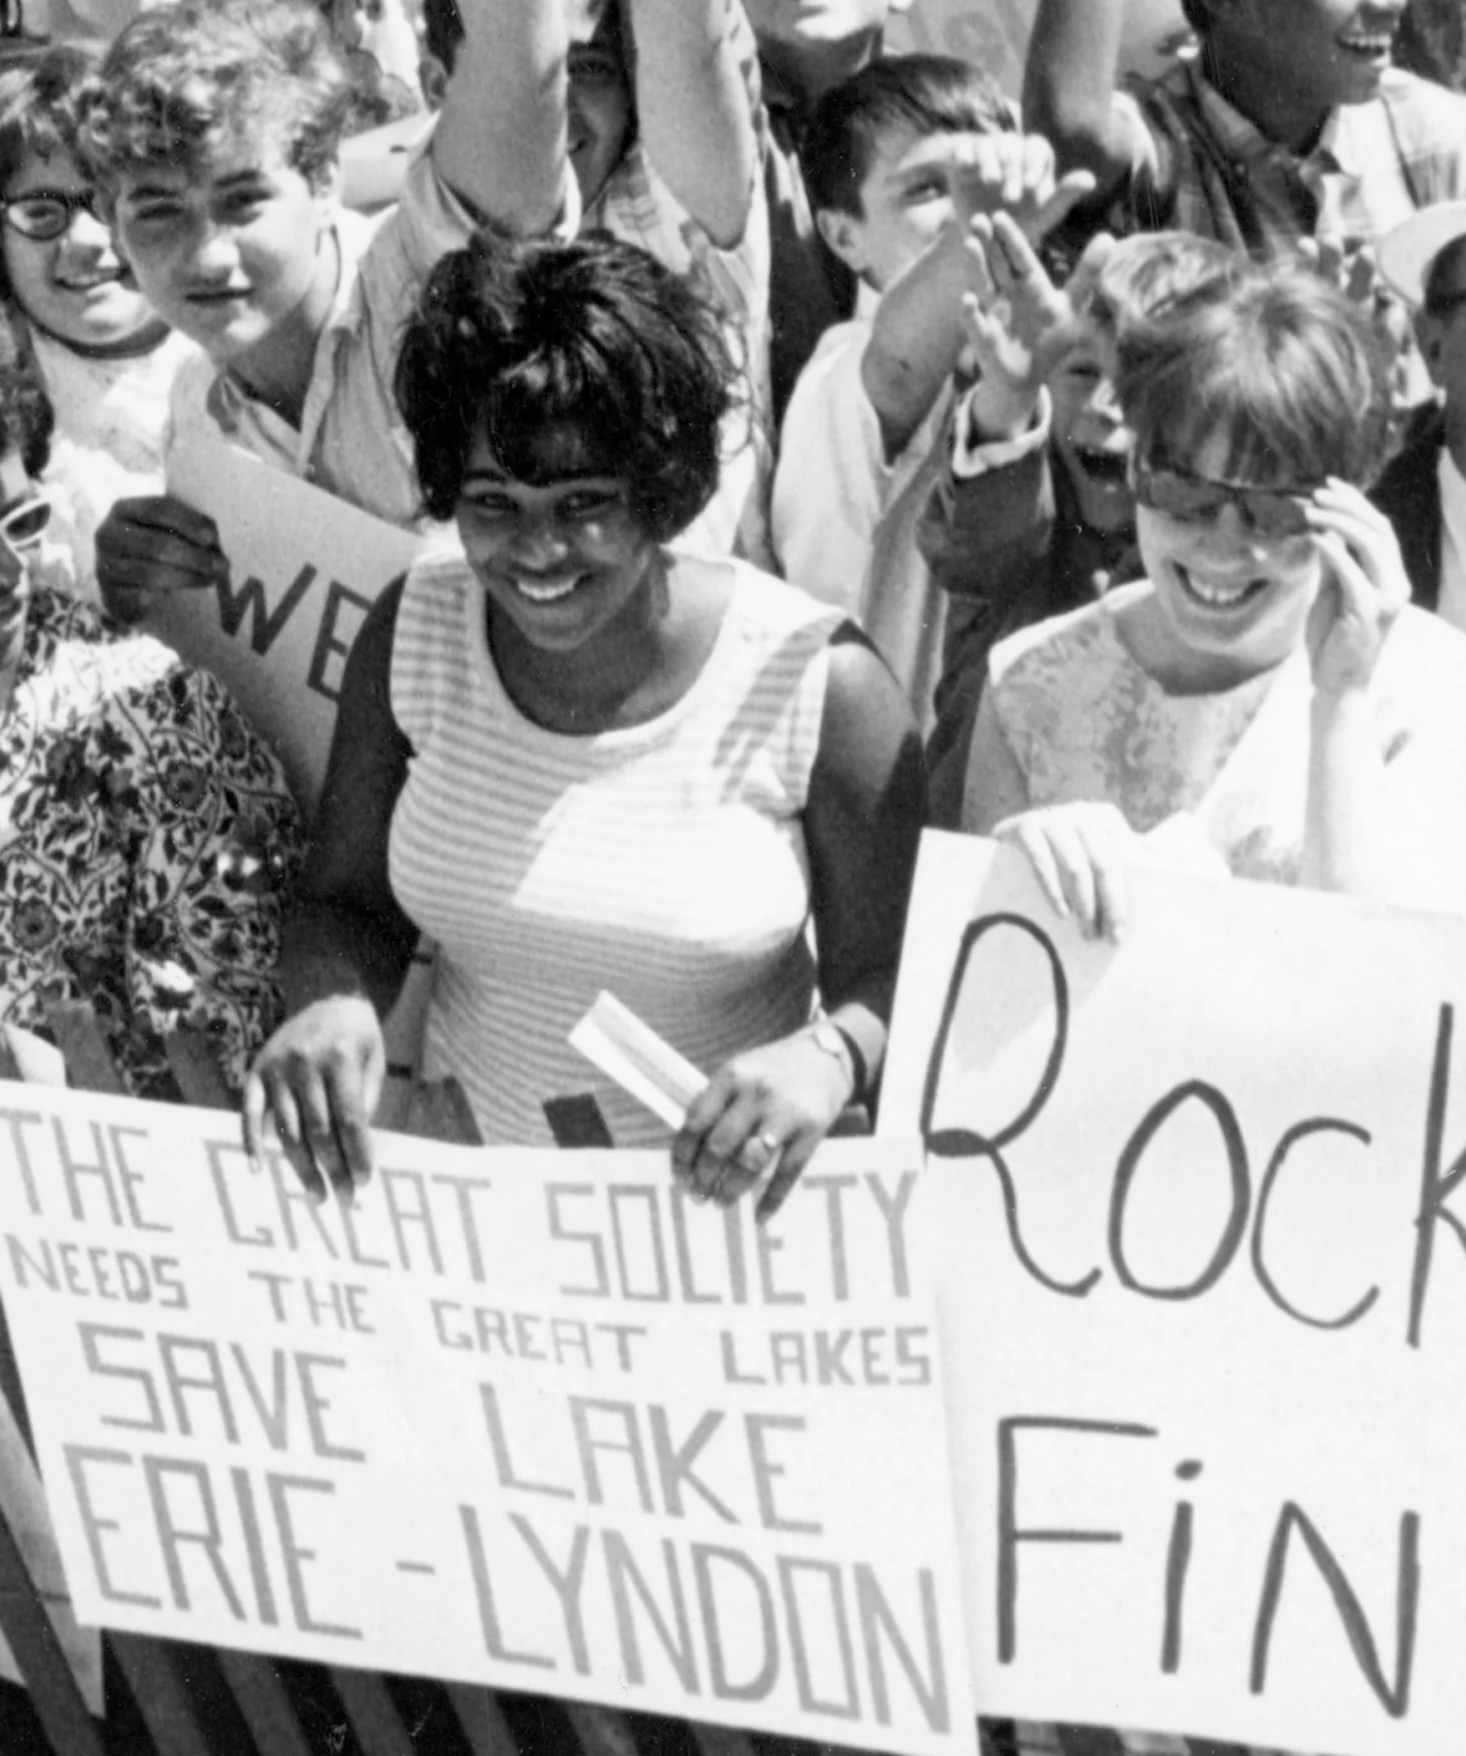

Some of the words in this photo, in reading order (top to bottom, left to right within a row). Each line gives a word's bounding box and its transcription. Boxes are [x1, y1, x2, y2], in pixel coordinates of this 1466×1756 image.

[217, 563, 374, 703] WE
[204, 1139, 492, 1284] GREAT
[544, 1170, 918, 1305] SOCIETY
[3, 1232, 189, 1310] NEEDS
[248, 1270, 374, 1334] THE
[430, 1298, 648, 1374] GREAT
[718, 1325, 931, 1386] LAKES
[78, 1321, 366, 1463] SAVE
[479, 1381, 824, 1535] LAKE
[62, 1443, 363, 1641] ERIE
[458, 1502, 951, 1736] LYNDON
